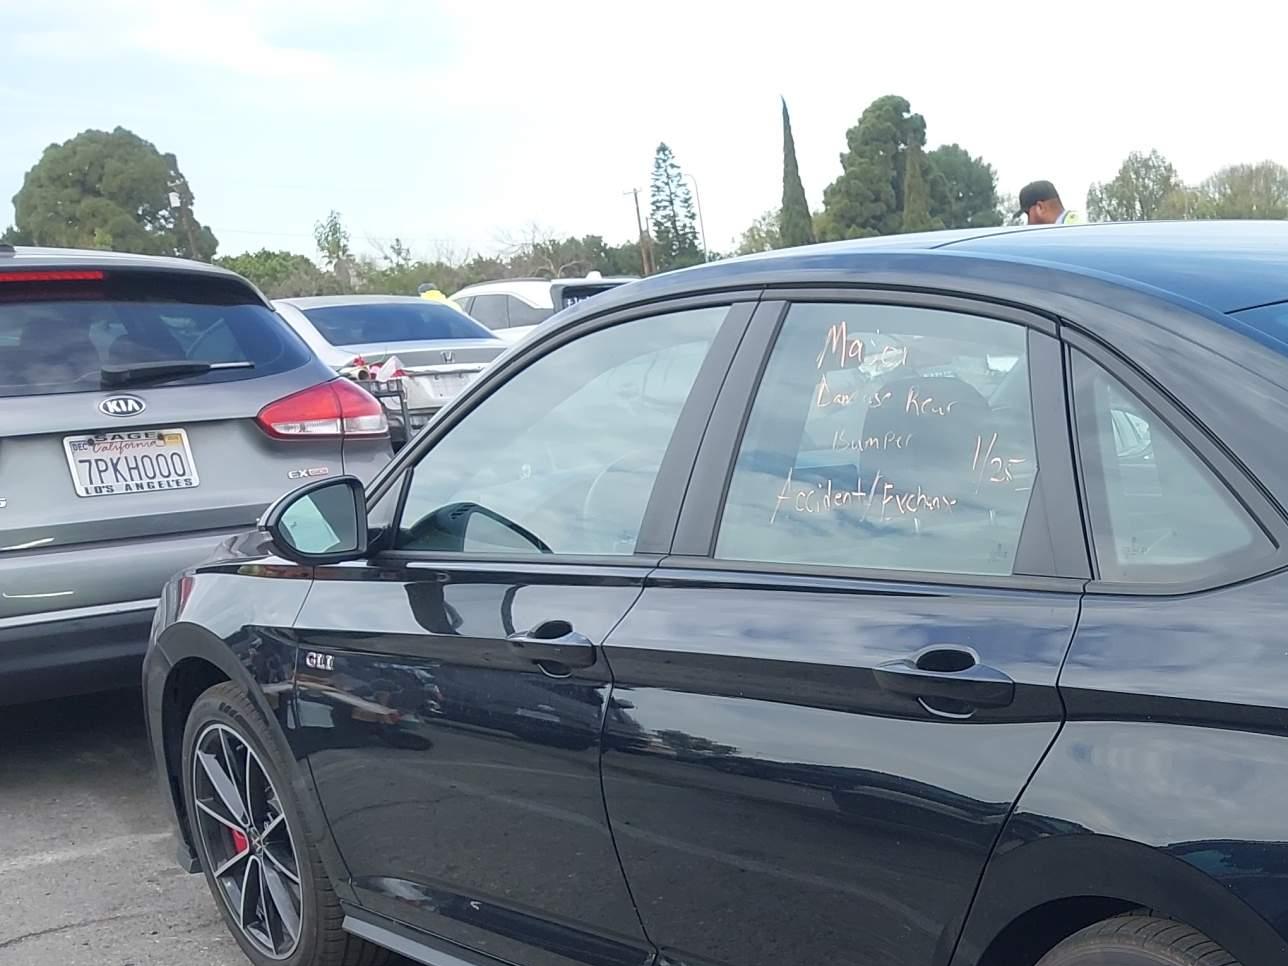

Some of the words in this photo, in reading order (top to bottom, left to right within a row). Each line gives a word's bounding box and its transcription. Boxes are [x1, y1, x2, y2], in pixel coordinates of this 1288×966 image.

[106, 399, 140, 413] KIA
[95, 432, 159, 442] SAGE
[93, 440, 158, 455] California
[78, 452, 187, 485] 7PKH000
[84, 484, 115, 495] LOS
[125, 478, 193, 491] ANGELES
[306, 651, 335, 671] GLI
